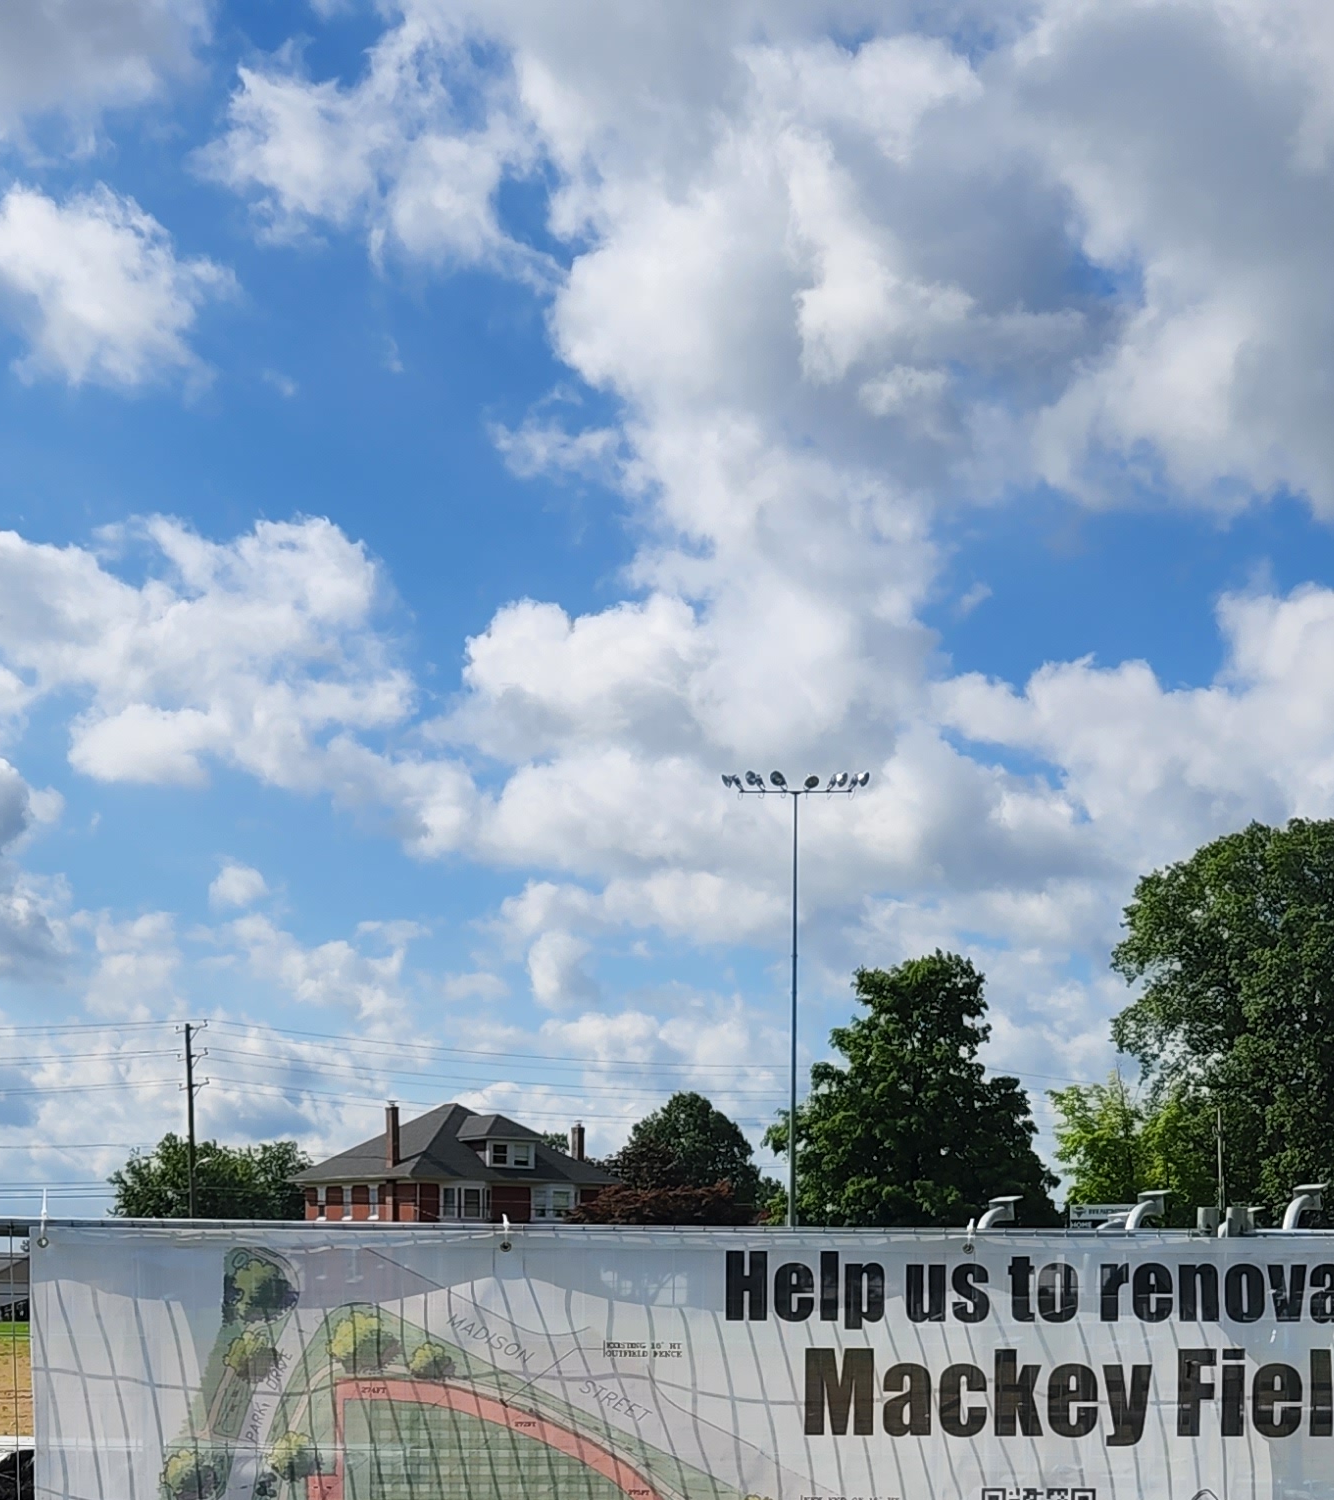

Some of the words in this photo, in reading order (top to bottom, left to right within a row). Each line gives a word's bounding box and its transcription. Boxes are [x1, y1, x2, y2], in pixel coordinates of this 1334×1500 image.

[725, 1250, 885, 1330] Help
[906, 1262, 991, 1324] us
[1009, 1256, 1078, 1324] to
[245, 1402, 268, 1444] PARK
[266, 1347, 293, 1391] DRIVE
[446, 1313, 536, 1364] MADISON
[579, 1379, 653, 1422] STREET
[804, 1348, 1153, 1447] Mackey
